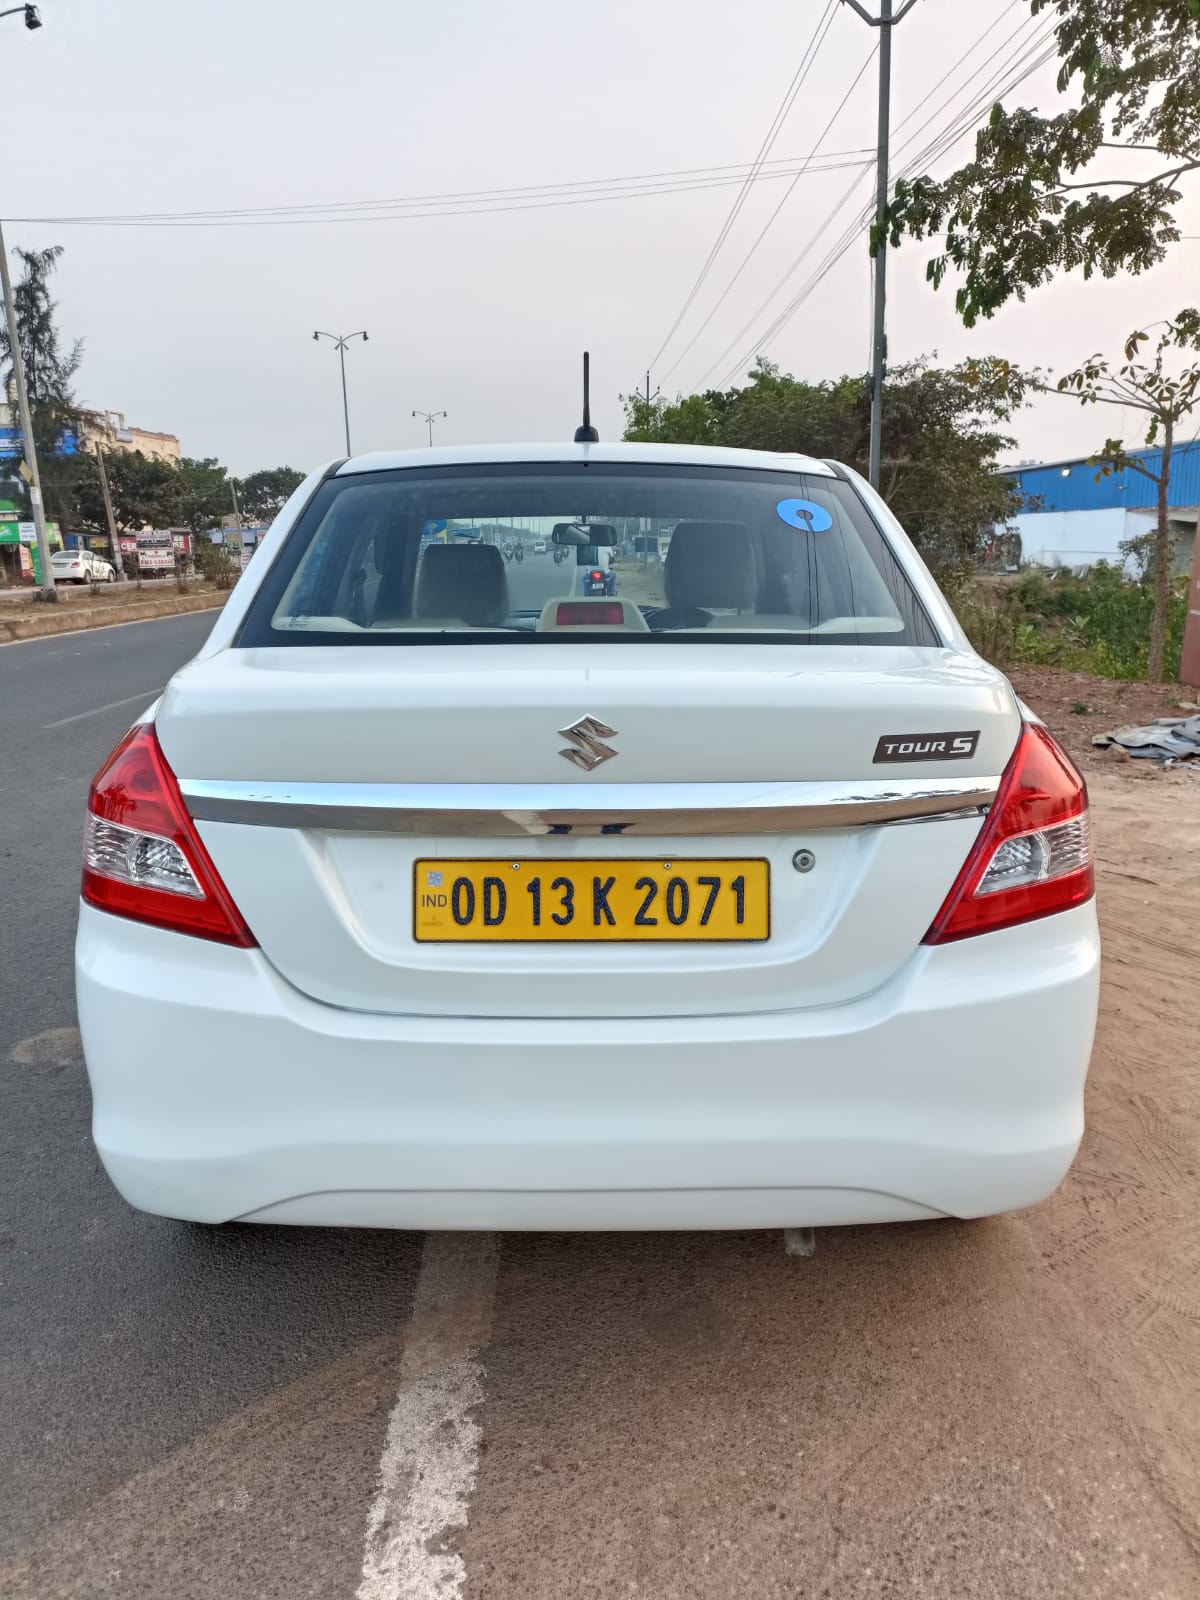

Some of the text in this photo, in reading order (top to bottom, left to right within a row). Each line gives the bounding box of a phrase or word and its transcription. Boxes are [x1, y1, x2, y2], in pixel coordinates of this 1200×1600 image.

[885, 737, 974, 754] TOUR S
[422, 894, 447, 907] IND
[526, 876, 575, 926] 13
[593, 876, 616, 926] K
[634, 875, 745, 926] 2071
